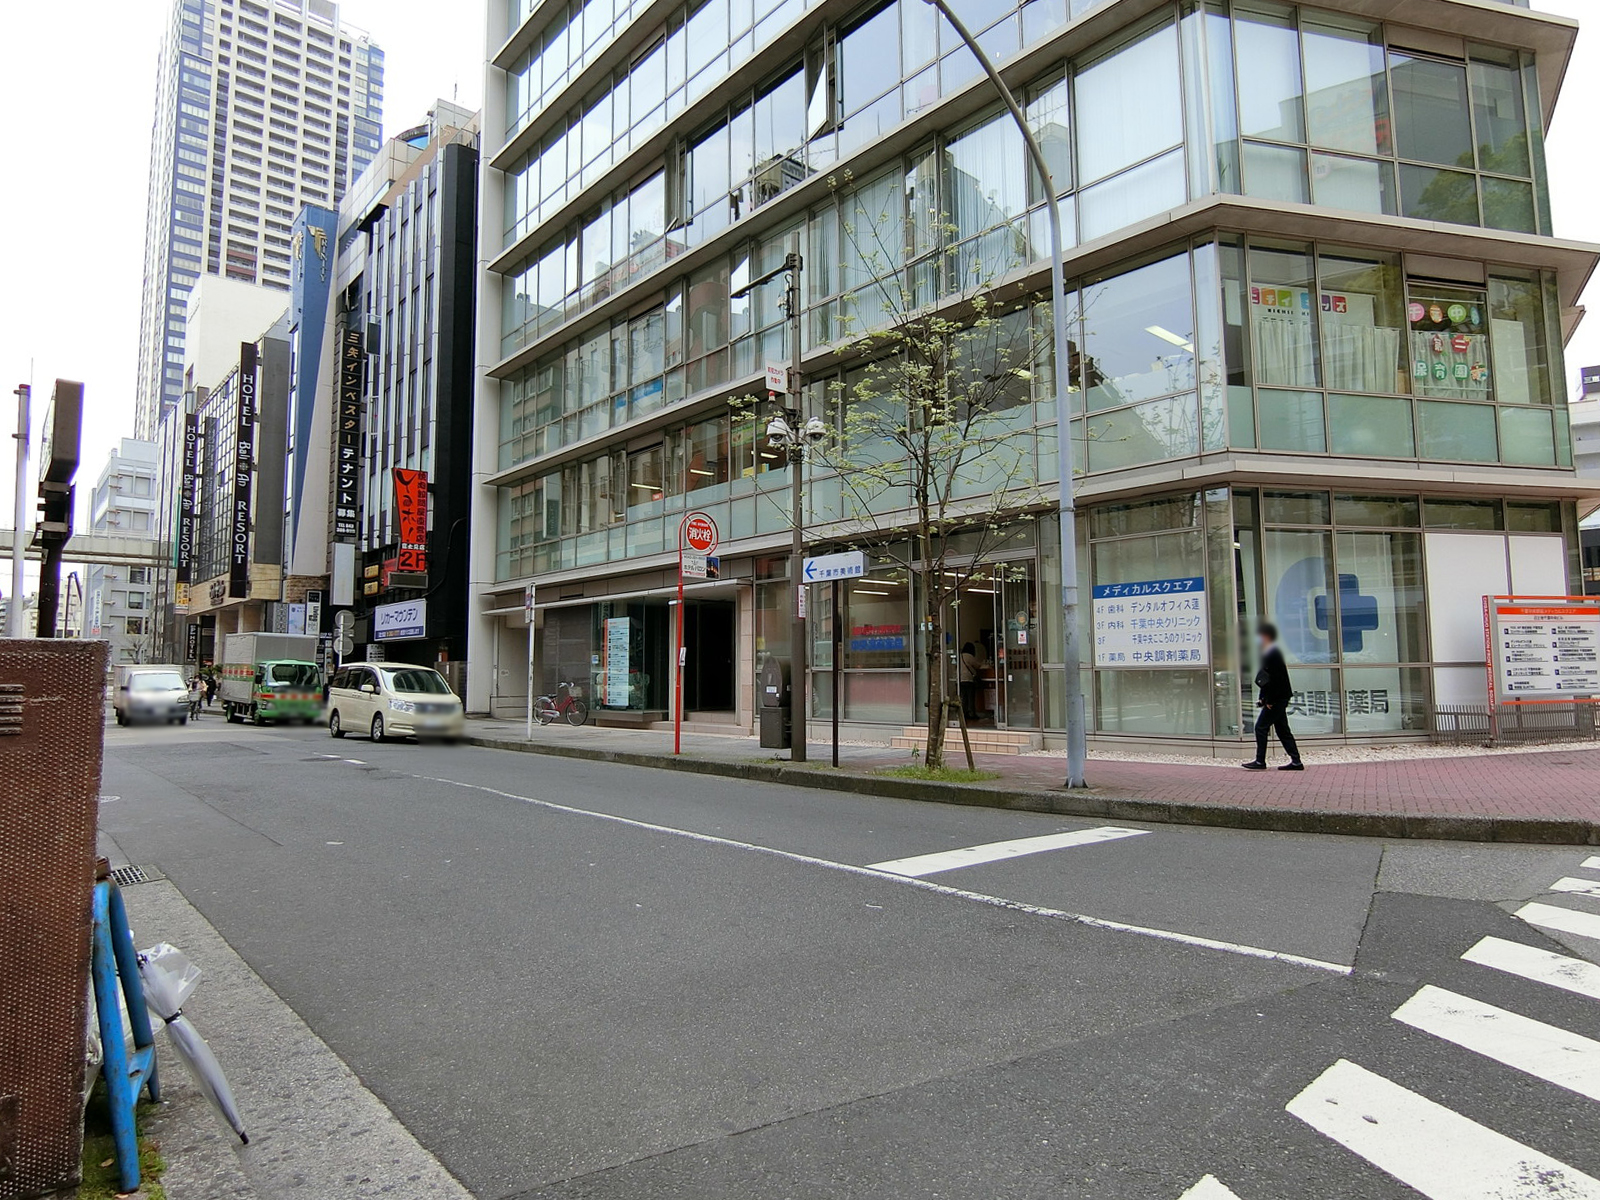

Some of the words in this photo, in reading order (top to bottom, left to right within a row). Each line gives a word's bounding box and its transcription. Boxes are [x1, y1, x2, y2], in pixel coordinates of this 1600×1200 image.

[1433, 337, 1467, 352] 第二
[1415, 362, 1468, 379] 保育園
[344, 332, 360, 444] 三矢インベスター
[241, 374, 254, 427] HOTEL
[186, 425, 196, 467] HOTEL
[341, 448, 355, 504] テナント
[235, 501, 248, 564] RESORT
[688, 526, 712, 542] 消火栓
[180, 518, 191, 568] RESORT
[400, 550, 426, 569] 2F
[819, 565, 861, 578] 千葉市美術館
[1102, 580, 1194, 597] メディカルスクエア
[1096, 606, 1105, 614] 4F
[1107, 604, 1125, 614] 歯科
[1130, 597, 1200, 613] デンタルオフィス蓮
[380, 607, 419, 626] リカーマウンテン
[1096, 622, 1105, 630] 3F
[1107, 620, 1125, 630] 内科
[1130, 615, 1201, 630] 千葉中央クリニック
[1097, 637, 1106, 645] 3F
[1132, 632, 1203, 645] 千葉中央こころのクリニック
[1098, 654, 1106, 662] 1F
[1108, 652, 1126, 662] 薬局
[1132, 649, 1202, 662] 中央調剤薬局
[1286, 689, 1389, 717] 央調剤薬局
